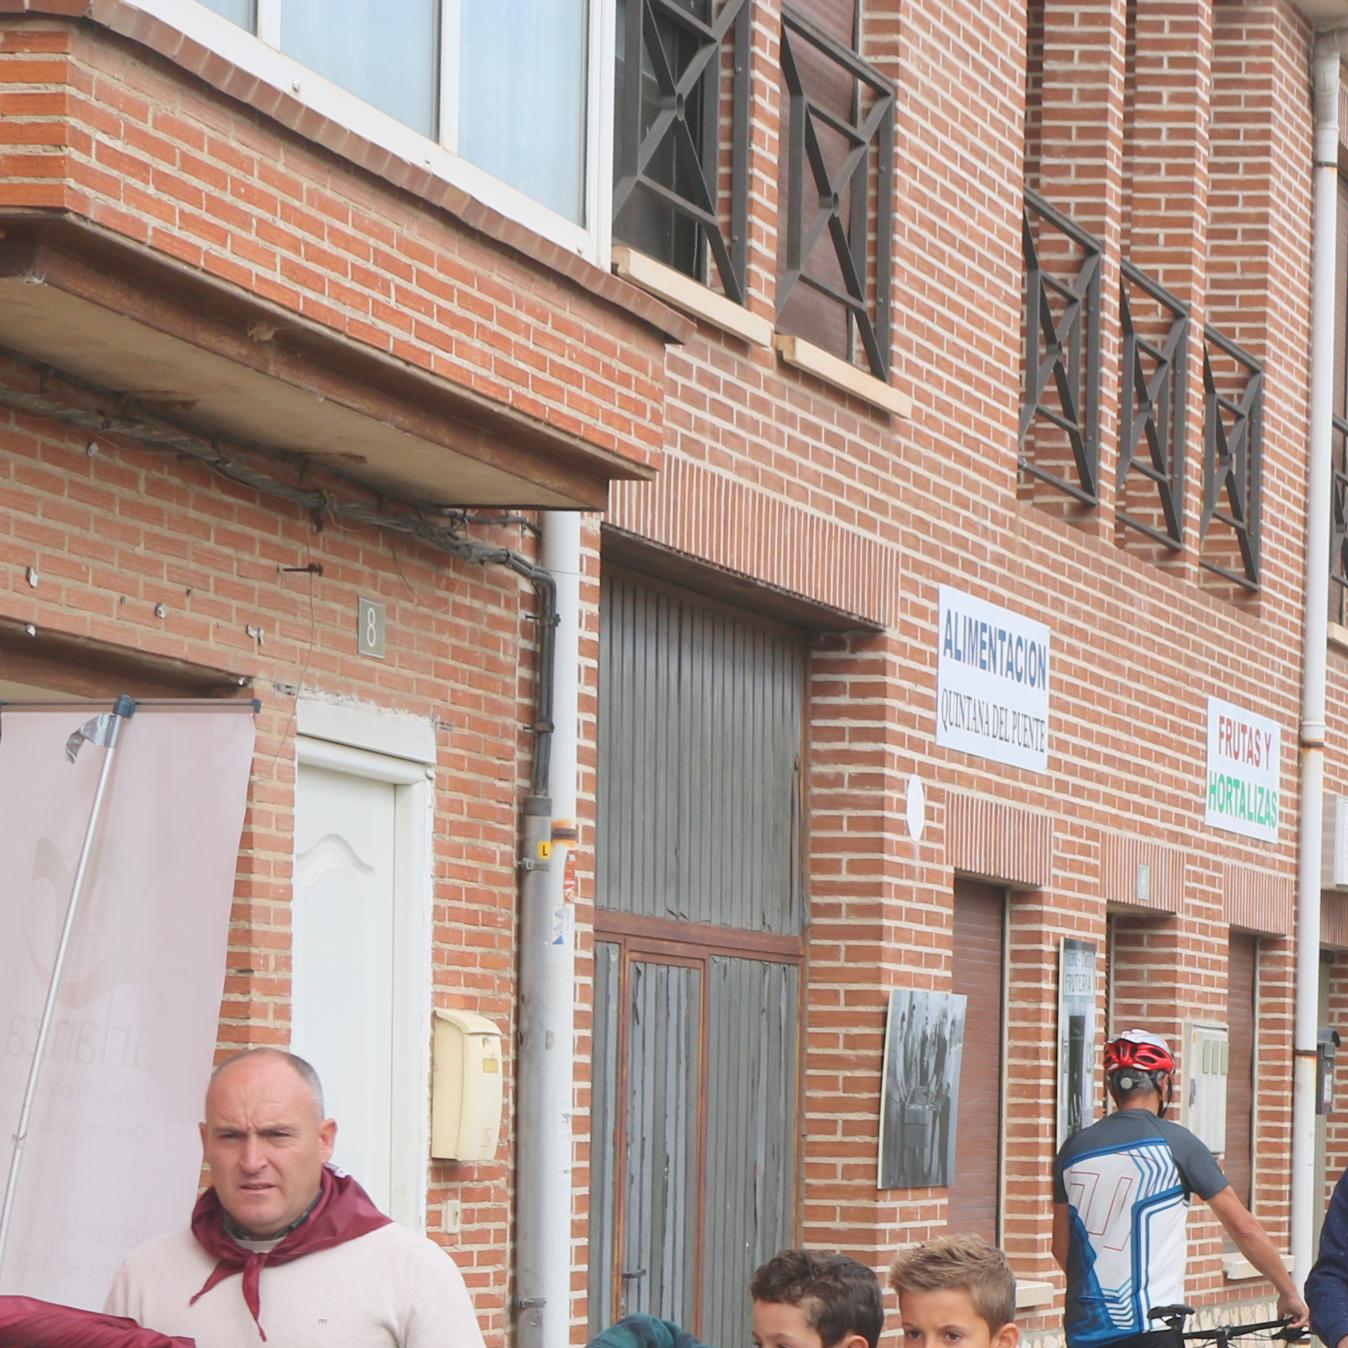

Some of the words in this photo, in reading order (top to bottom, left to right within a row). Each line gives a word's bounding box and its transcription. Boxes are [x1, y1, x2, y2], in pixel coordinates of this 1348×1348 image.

[367, 607, 376, 647] 8
[943, 608, 1047, 691] ALIMENTACION
[941, 688, 990, 735] QUINTANA
[991, 708, 1011, 744] DEL
[1012, 711, 1046, 754] PUENTE
[1218, 716, 1261, 769] FRUTAS
[1261, 731, 1272, 770] Y
[1208, 770, 1277, 829] HORTALIZAS
